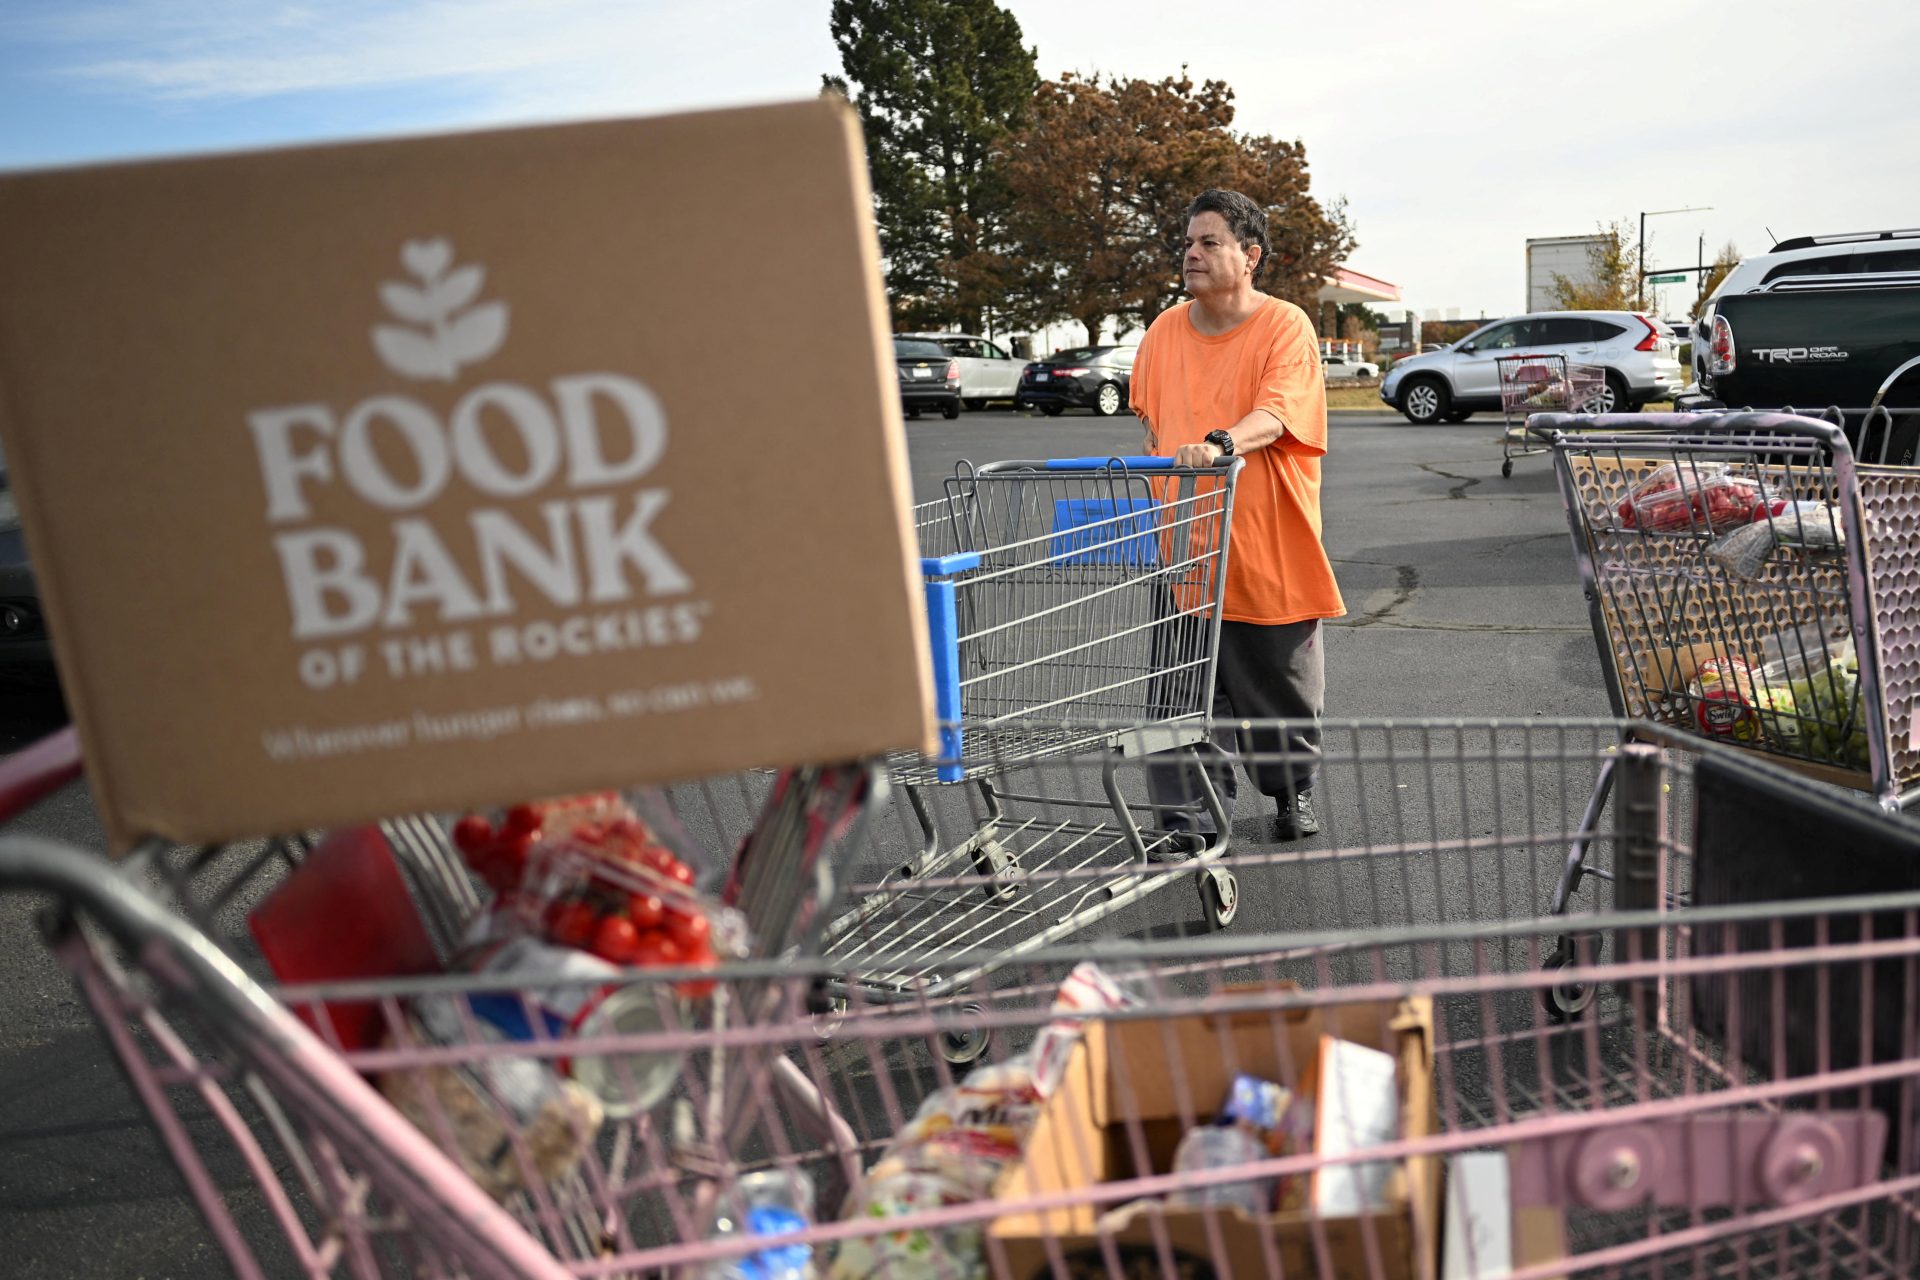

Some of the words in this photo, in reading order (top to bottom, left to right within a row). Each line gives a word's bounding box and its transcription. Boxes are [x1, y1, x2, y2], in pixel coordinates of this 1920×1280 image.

[1752, 347, 1808, 363] TRD
[247, 371, 668, 522] FOOD
[274, 488, 694, 640] BANK
[298, 644, 366, 689] OF
[380, 629, 476, 680] THE
[490, 603, 701, 663] ROCKIES
